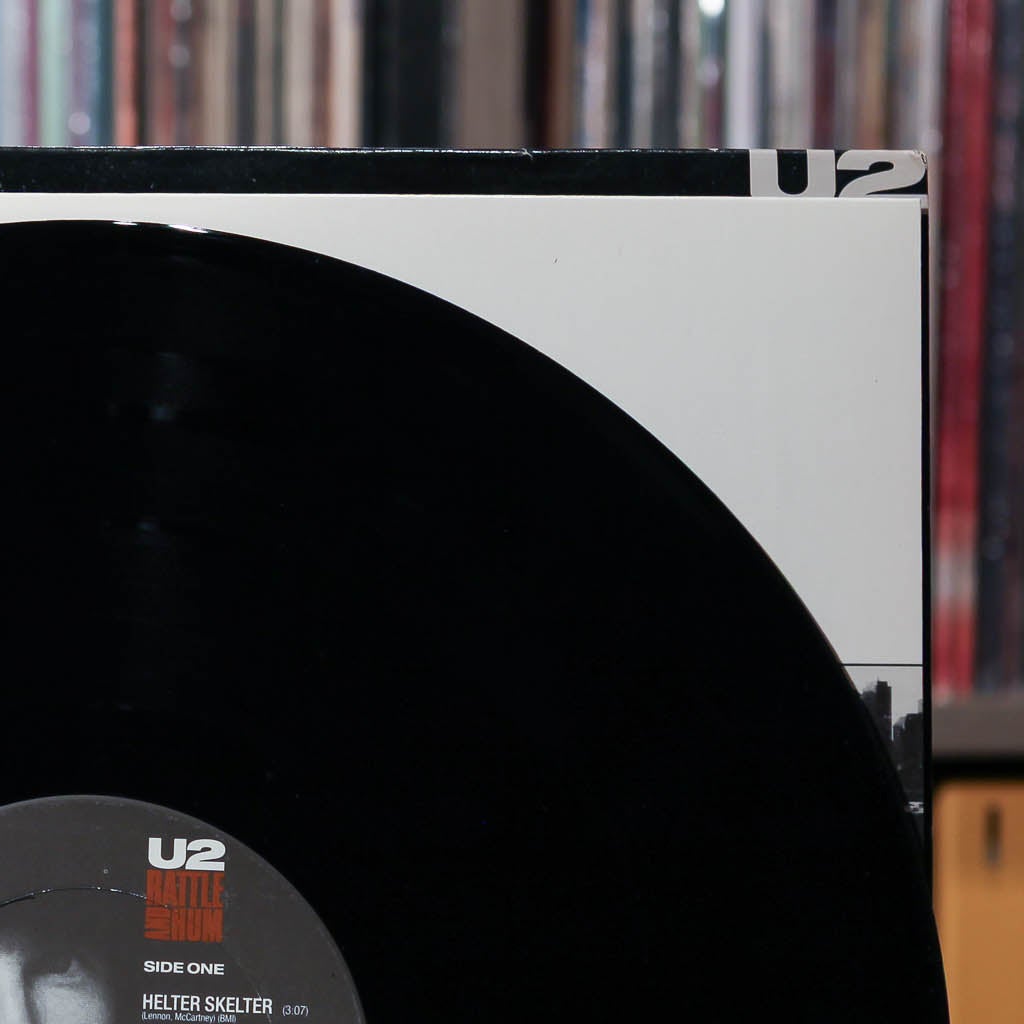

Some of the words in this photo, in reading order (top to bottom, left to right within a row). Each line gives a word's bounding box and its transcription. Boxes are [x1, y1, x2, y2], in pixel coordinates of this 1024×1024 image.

[750, 149, 927, 197] U2
[148, 838, 225, 871] U2
[146, 869, 225, 908] RATTLE
[171, 908, 224, 943] HUM
[144, 961, 184, 974] SIDE
[187, 963, 224, 975] ONE
[141, 1012, 172, 1021] (Lennon,
[175, 1013, 215, 1023] McCartney)
[218, 1014, 236, 1023] (BMI)
[143, 994, 200, 1011] HELTER
[205, 996, 272, 1014] SKELTER
[282, 1005, 308, 1016] (3:07)
